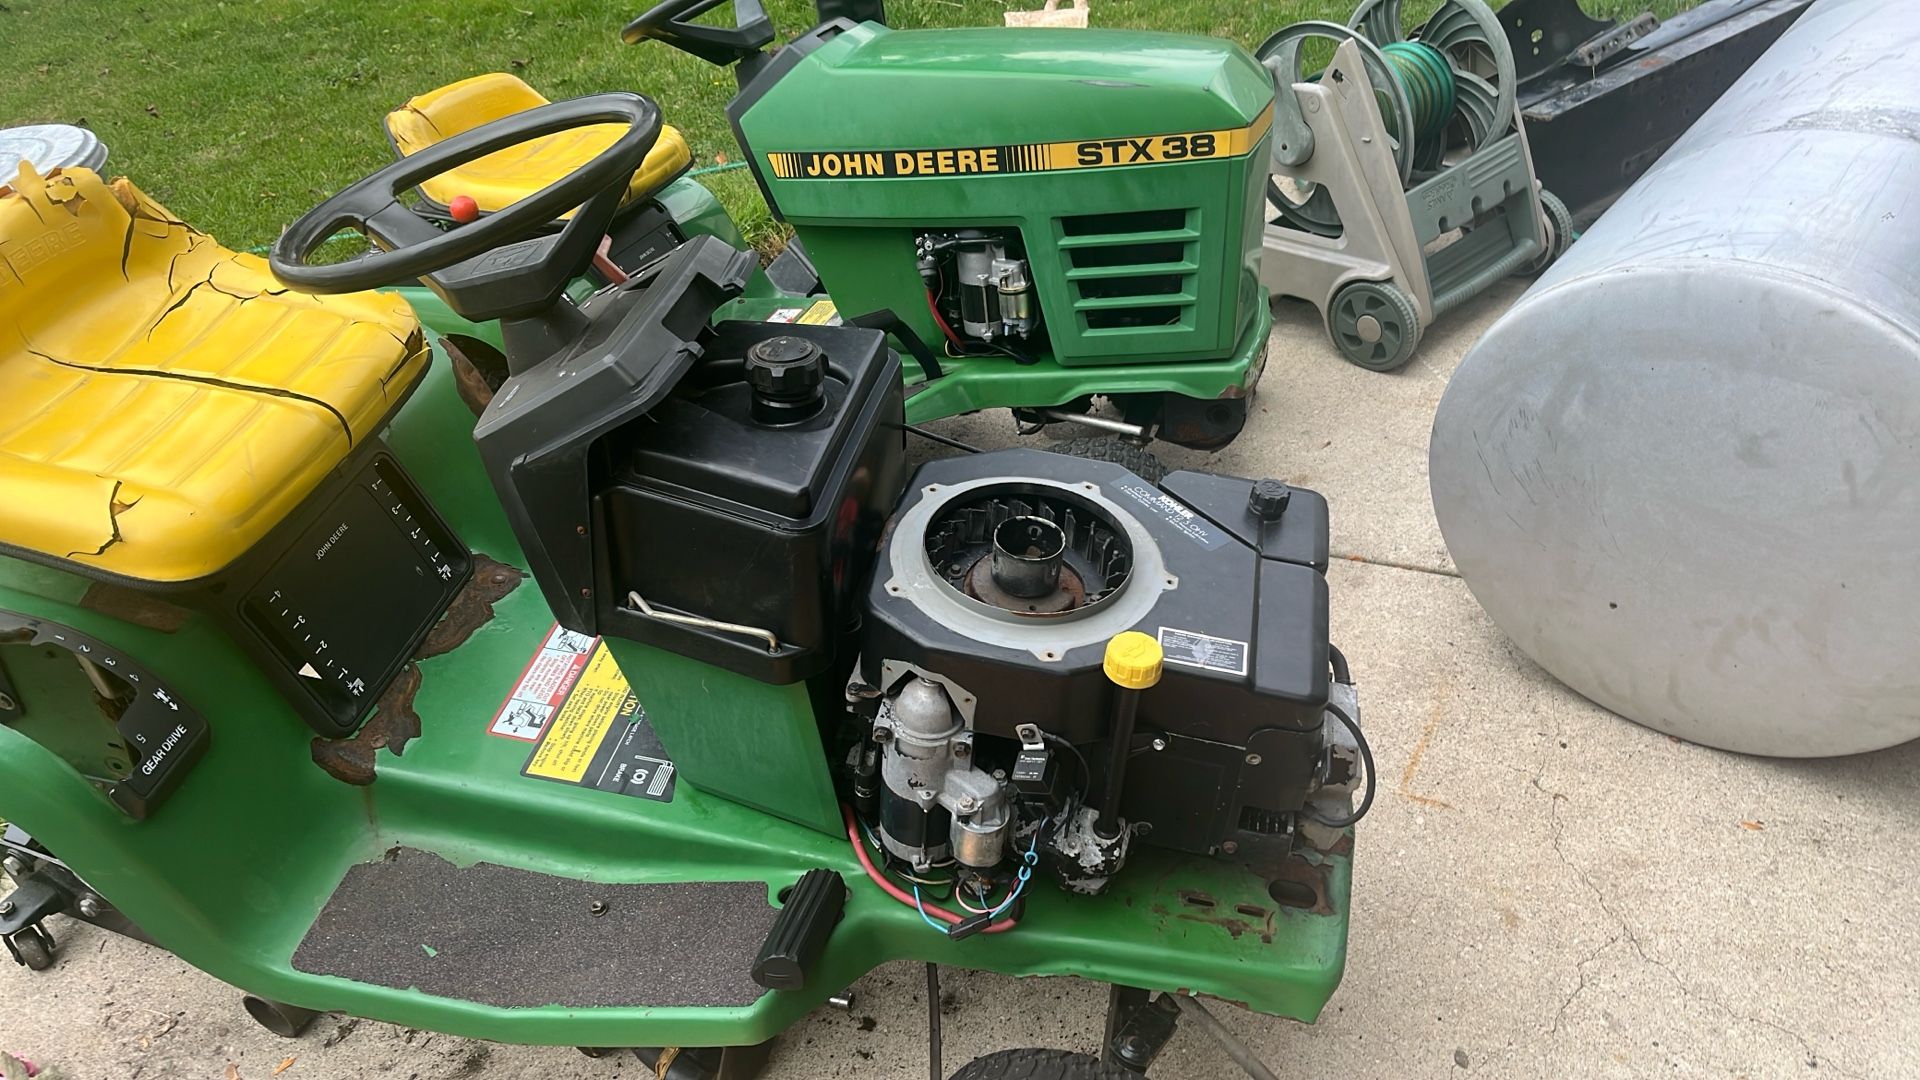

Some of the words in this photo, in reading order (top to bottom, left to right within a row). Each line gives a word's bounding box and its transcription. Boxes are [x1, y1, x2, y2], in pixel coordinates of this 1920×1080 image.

[807, 153, 884, 177] JOHN
[894, 148, 999, 175] DEERE
[1077, 138, 1155, 166] STX
[1162, 134, 1215, 160] 38
[391, 506, 399, 515] 3
[1158, 495, 1194, 520] KOHLER
[411, 530, 418, 539] 2
[316, 541, 331, 560] JOHN
[329, 522, 349, 544] DEERE
[298, 615, 306, 624] 3
[79, 644, 91, 653] 2
[320, 640, 328, 649] 2
[104, 657, 116, 666] 3
[129, 673, 139, 682] 4
[558, 669, 578, 696] DANGER
[136, 733, 147, 744] 5
[142, 748, 166, 775] GEAR
[162, 723, 187, 752] DRIVE
[612, 763, 627, 782] BRAKE
